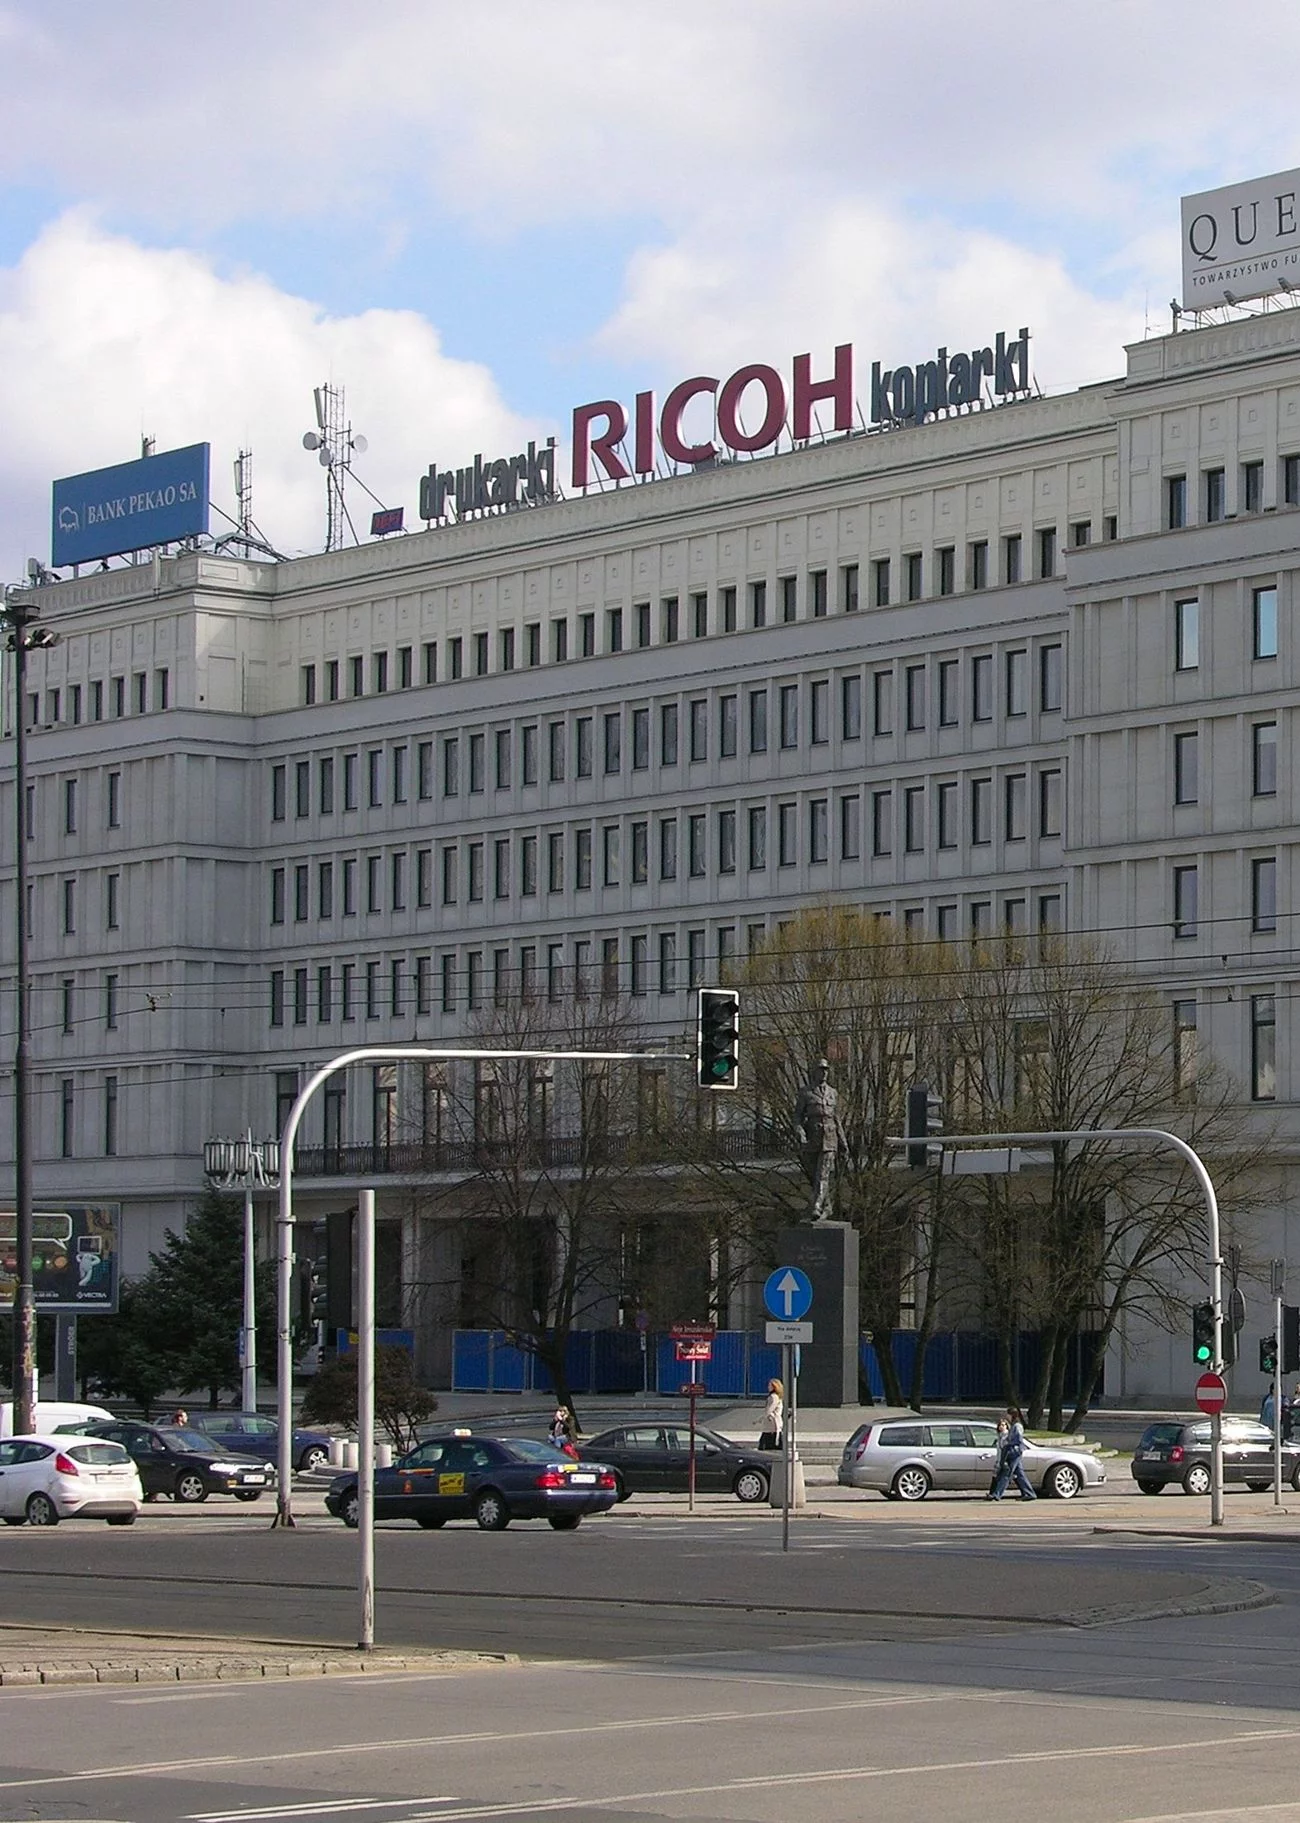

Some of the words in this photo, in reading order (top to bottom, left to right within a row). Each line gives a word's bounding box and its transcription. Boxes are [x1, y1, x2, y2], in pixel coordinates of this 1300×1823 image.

[1192, 260, 1278, 287] TOWARZYSTWO
[571, 343, 854, 489] RICOH
[870, 327, 1034, 425] kopiarki
[87, 498, 126, 525] BANK
[128, 486, 176, 515] PEKAO
[179, 480, 197, 502] SA
[419, 436, 556, 522] drukarki
